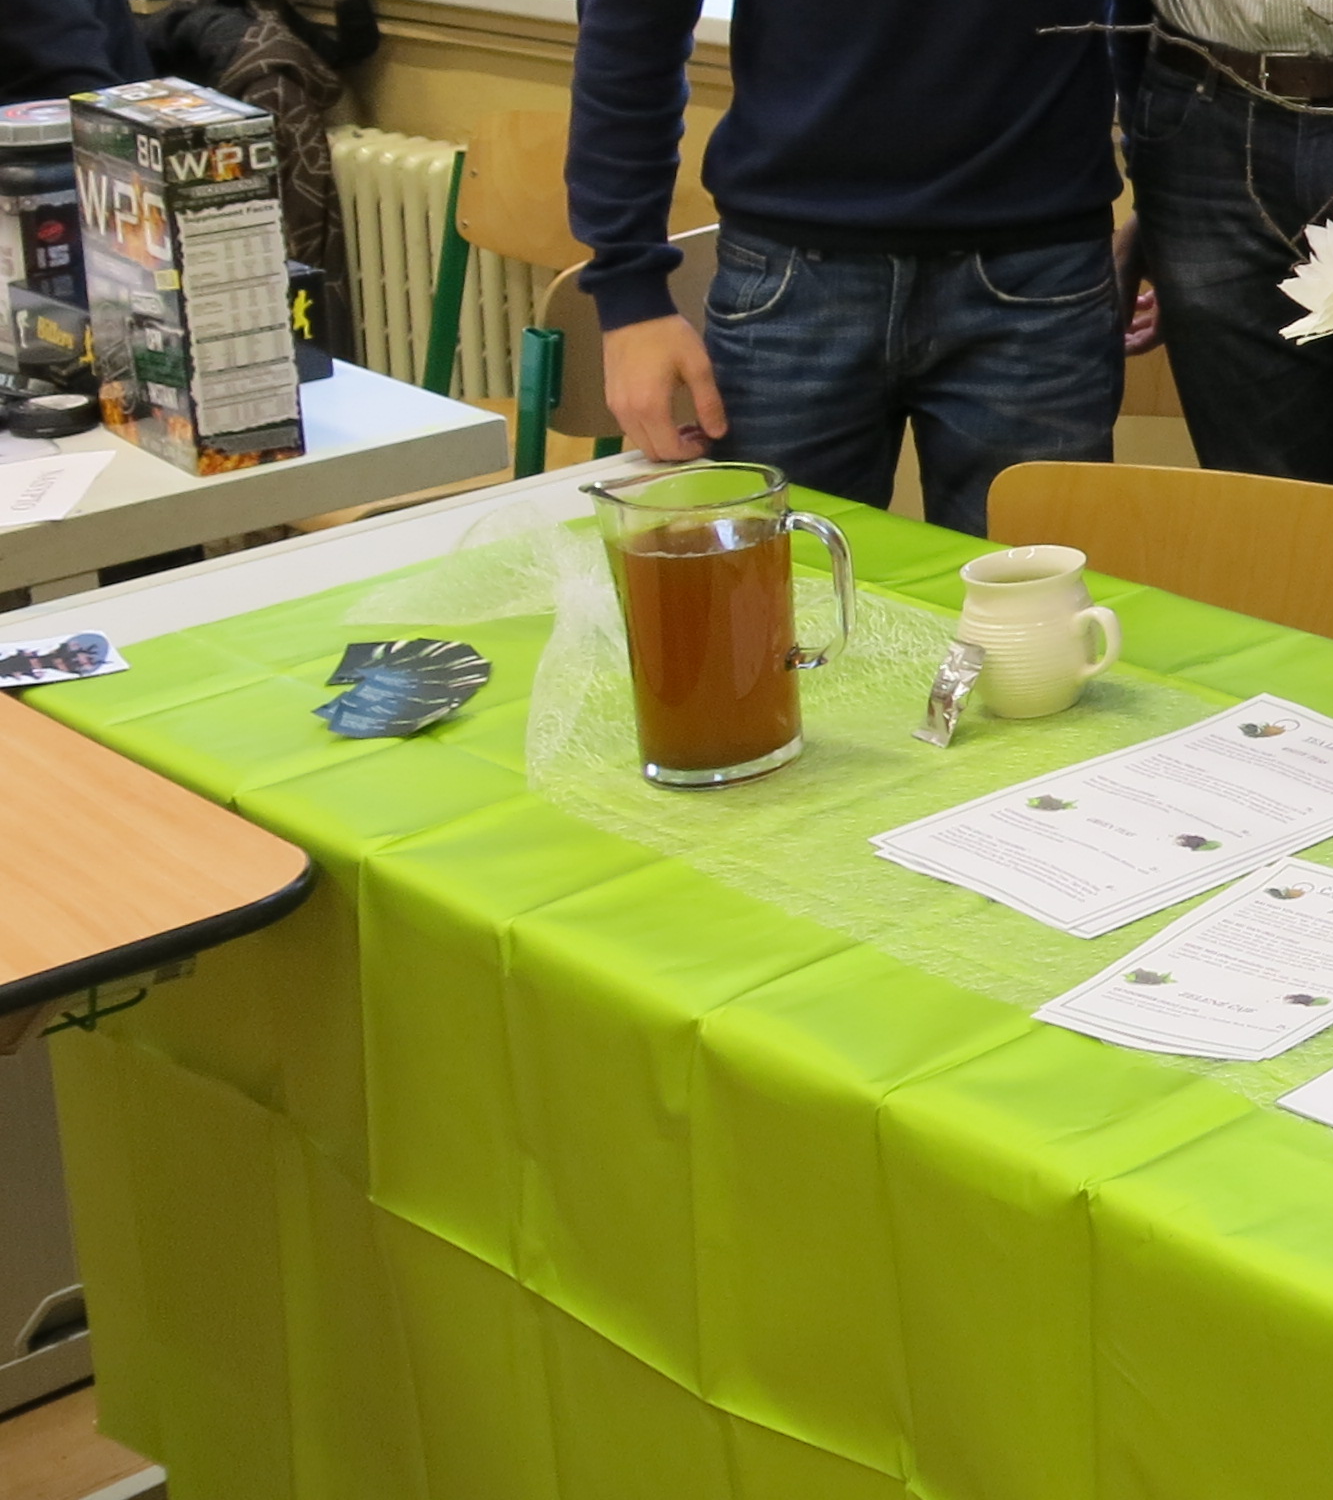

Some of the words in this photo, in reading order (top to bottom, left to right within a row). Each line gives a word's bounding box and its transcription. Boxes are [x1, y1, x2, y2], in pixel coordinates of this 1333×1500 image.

[136, 134, 163, 173] 80
[169, 141, 279, 181] WPC
[76, 165, 172, 262] WPC
